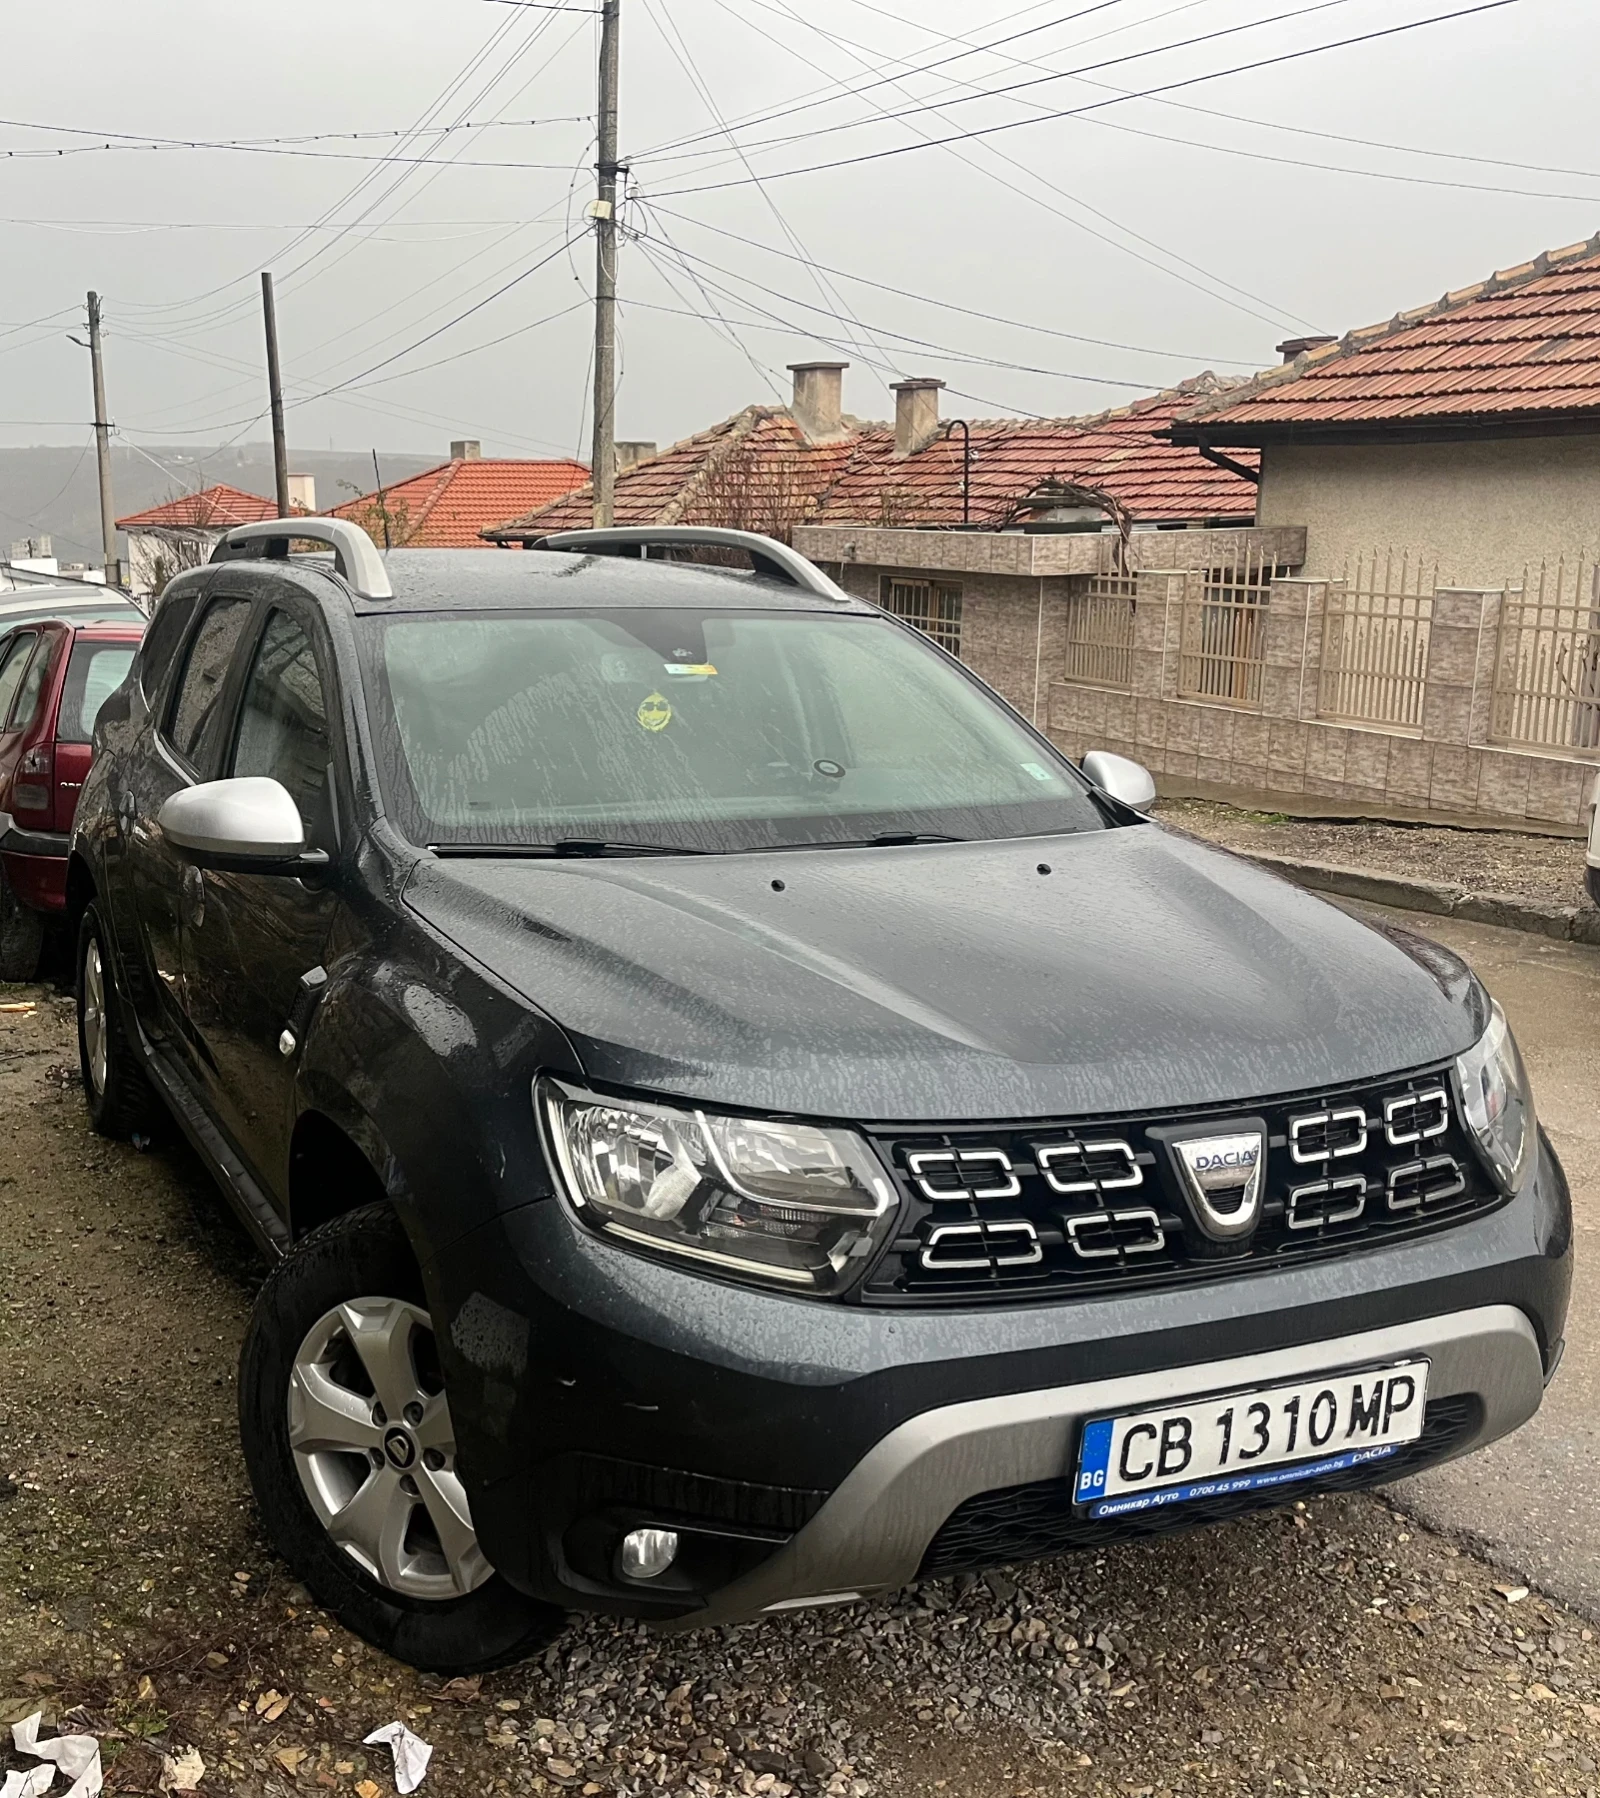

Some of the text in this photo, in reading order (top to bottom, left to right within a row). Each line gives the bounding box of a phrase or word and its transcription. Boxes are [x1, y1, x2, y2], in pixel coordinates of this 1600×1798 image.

[1195, 1150, 1254, 1170] DACIA
[1119, 1375, 1415, 1482] CB 1310 MP
[1080, 1469, 1104, 1490] BG
[1098, 1445, 1391, 1515] Омникар Ауто 0700 45 999 www.omnicar-auto.bg DACIA
